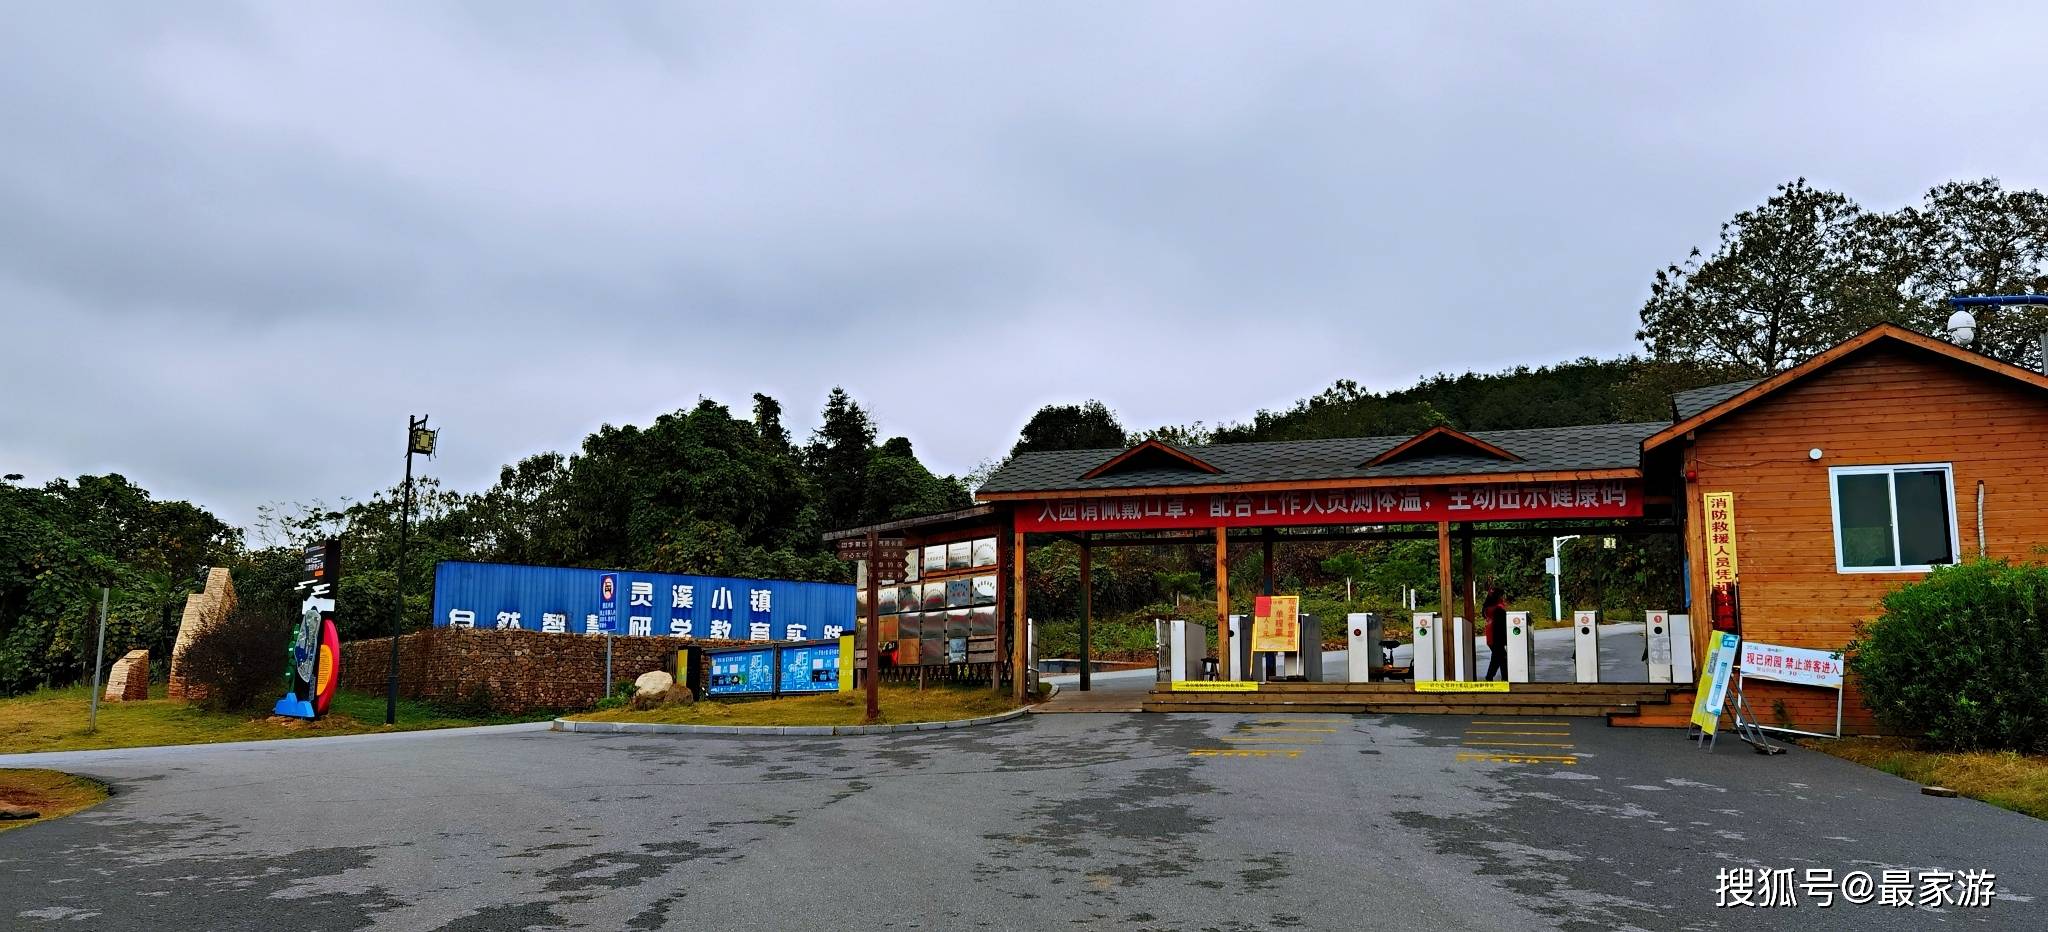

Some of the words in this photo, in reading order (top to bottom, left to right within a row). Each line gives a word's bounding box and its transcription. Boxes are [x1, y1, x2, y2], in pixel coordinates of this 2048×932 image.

[630, 581, 771, 613] 灵溪小镇
[1747, 652, 1782, 668] 现已闭园
[1785, 657, 1840, 675] 禁止游客进入
